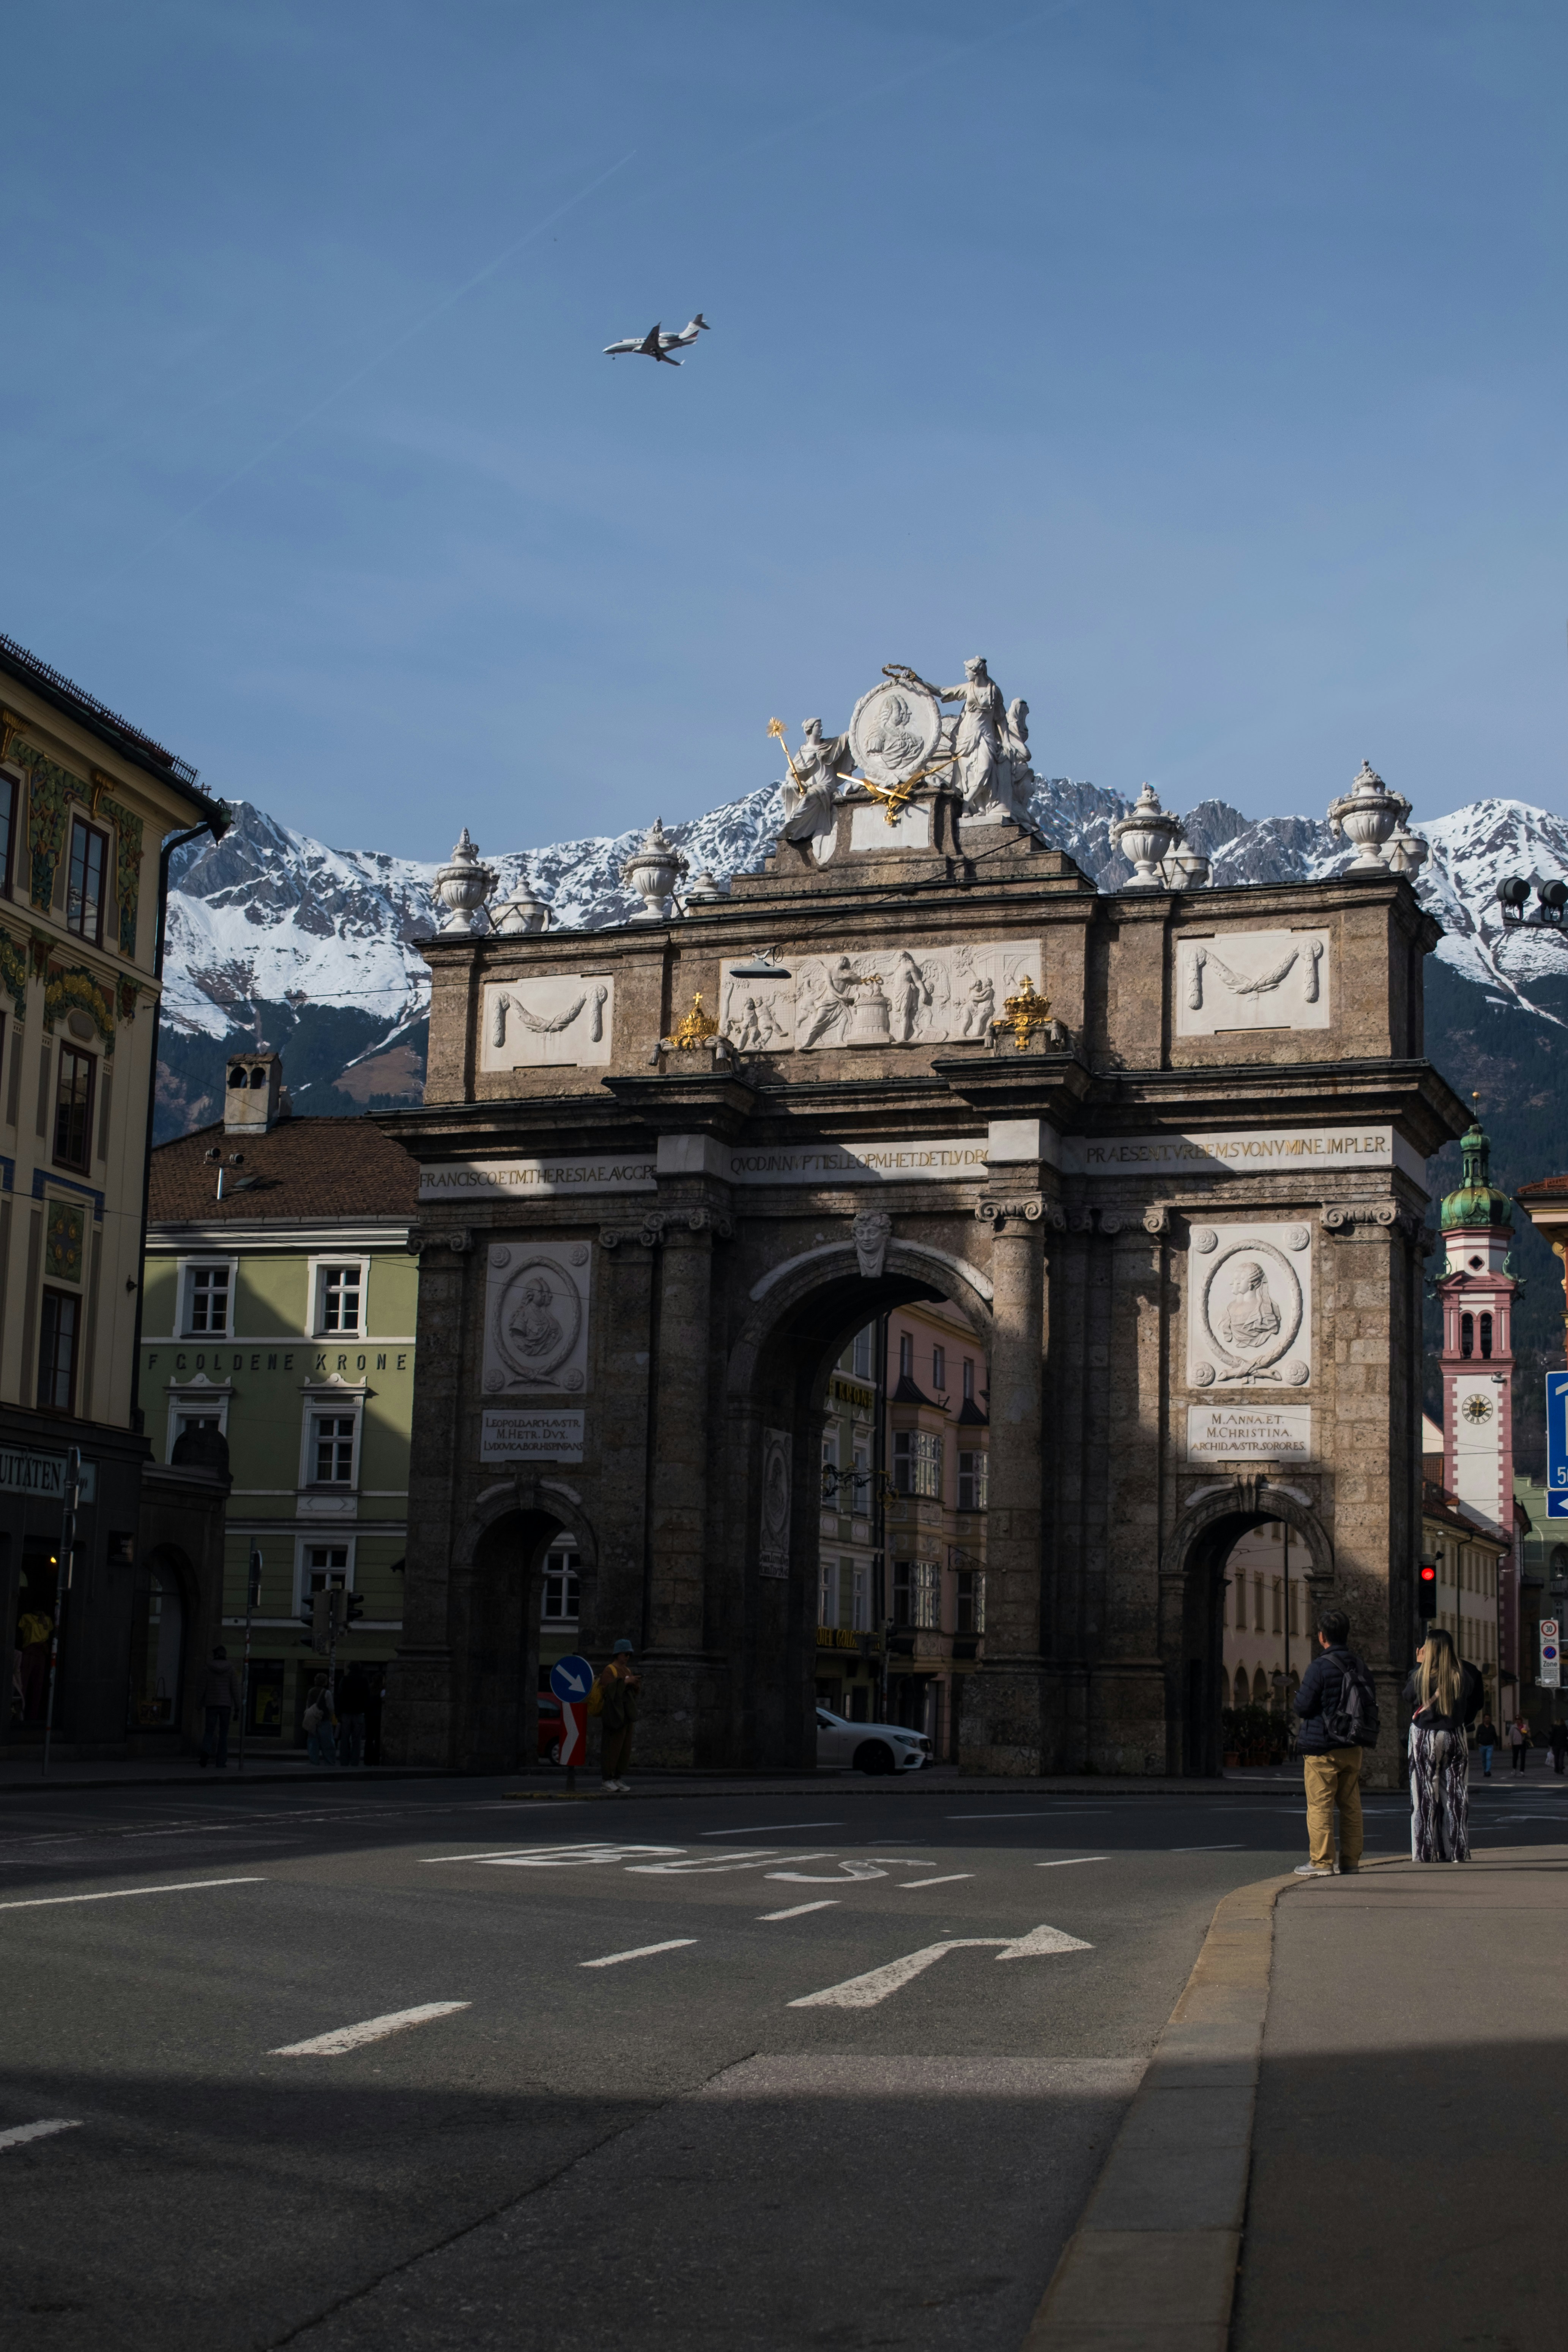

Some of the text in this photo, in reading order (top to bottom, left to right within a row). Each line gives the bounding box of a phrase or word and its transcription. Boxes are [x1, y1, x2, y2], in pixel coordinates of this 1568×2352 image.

[176, 1353, 293, 1370] GOLDENE
[315, 1353, 407, 1370] KRONE
[837, 1381, 873, 1409] KRONE
[474, 1845, 937, 1882] BUS
